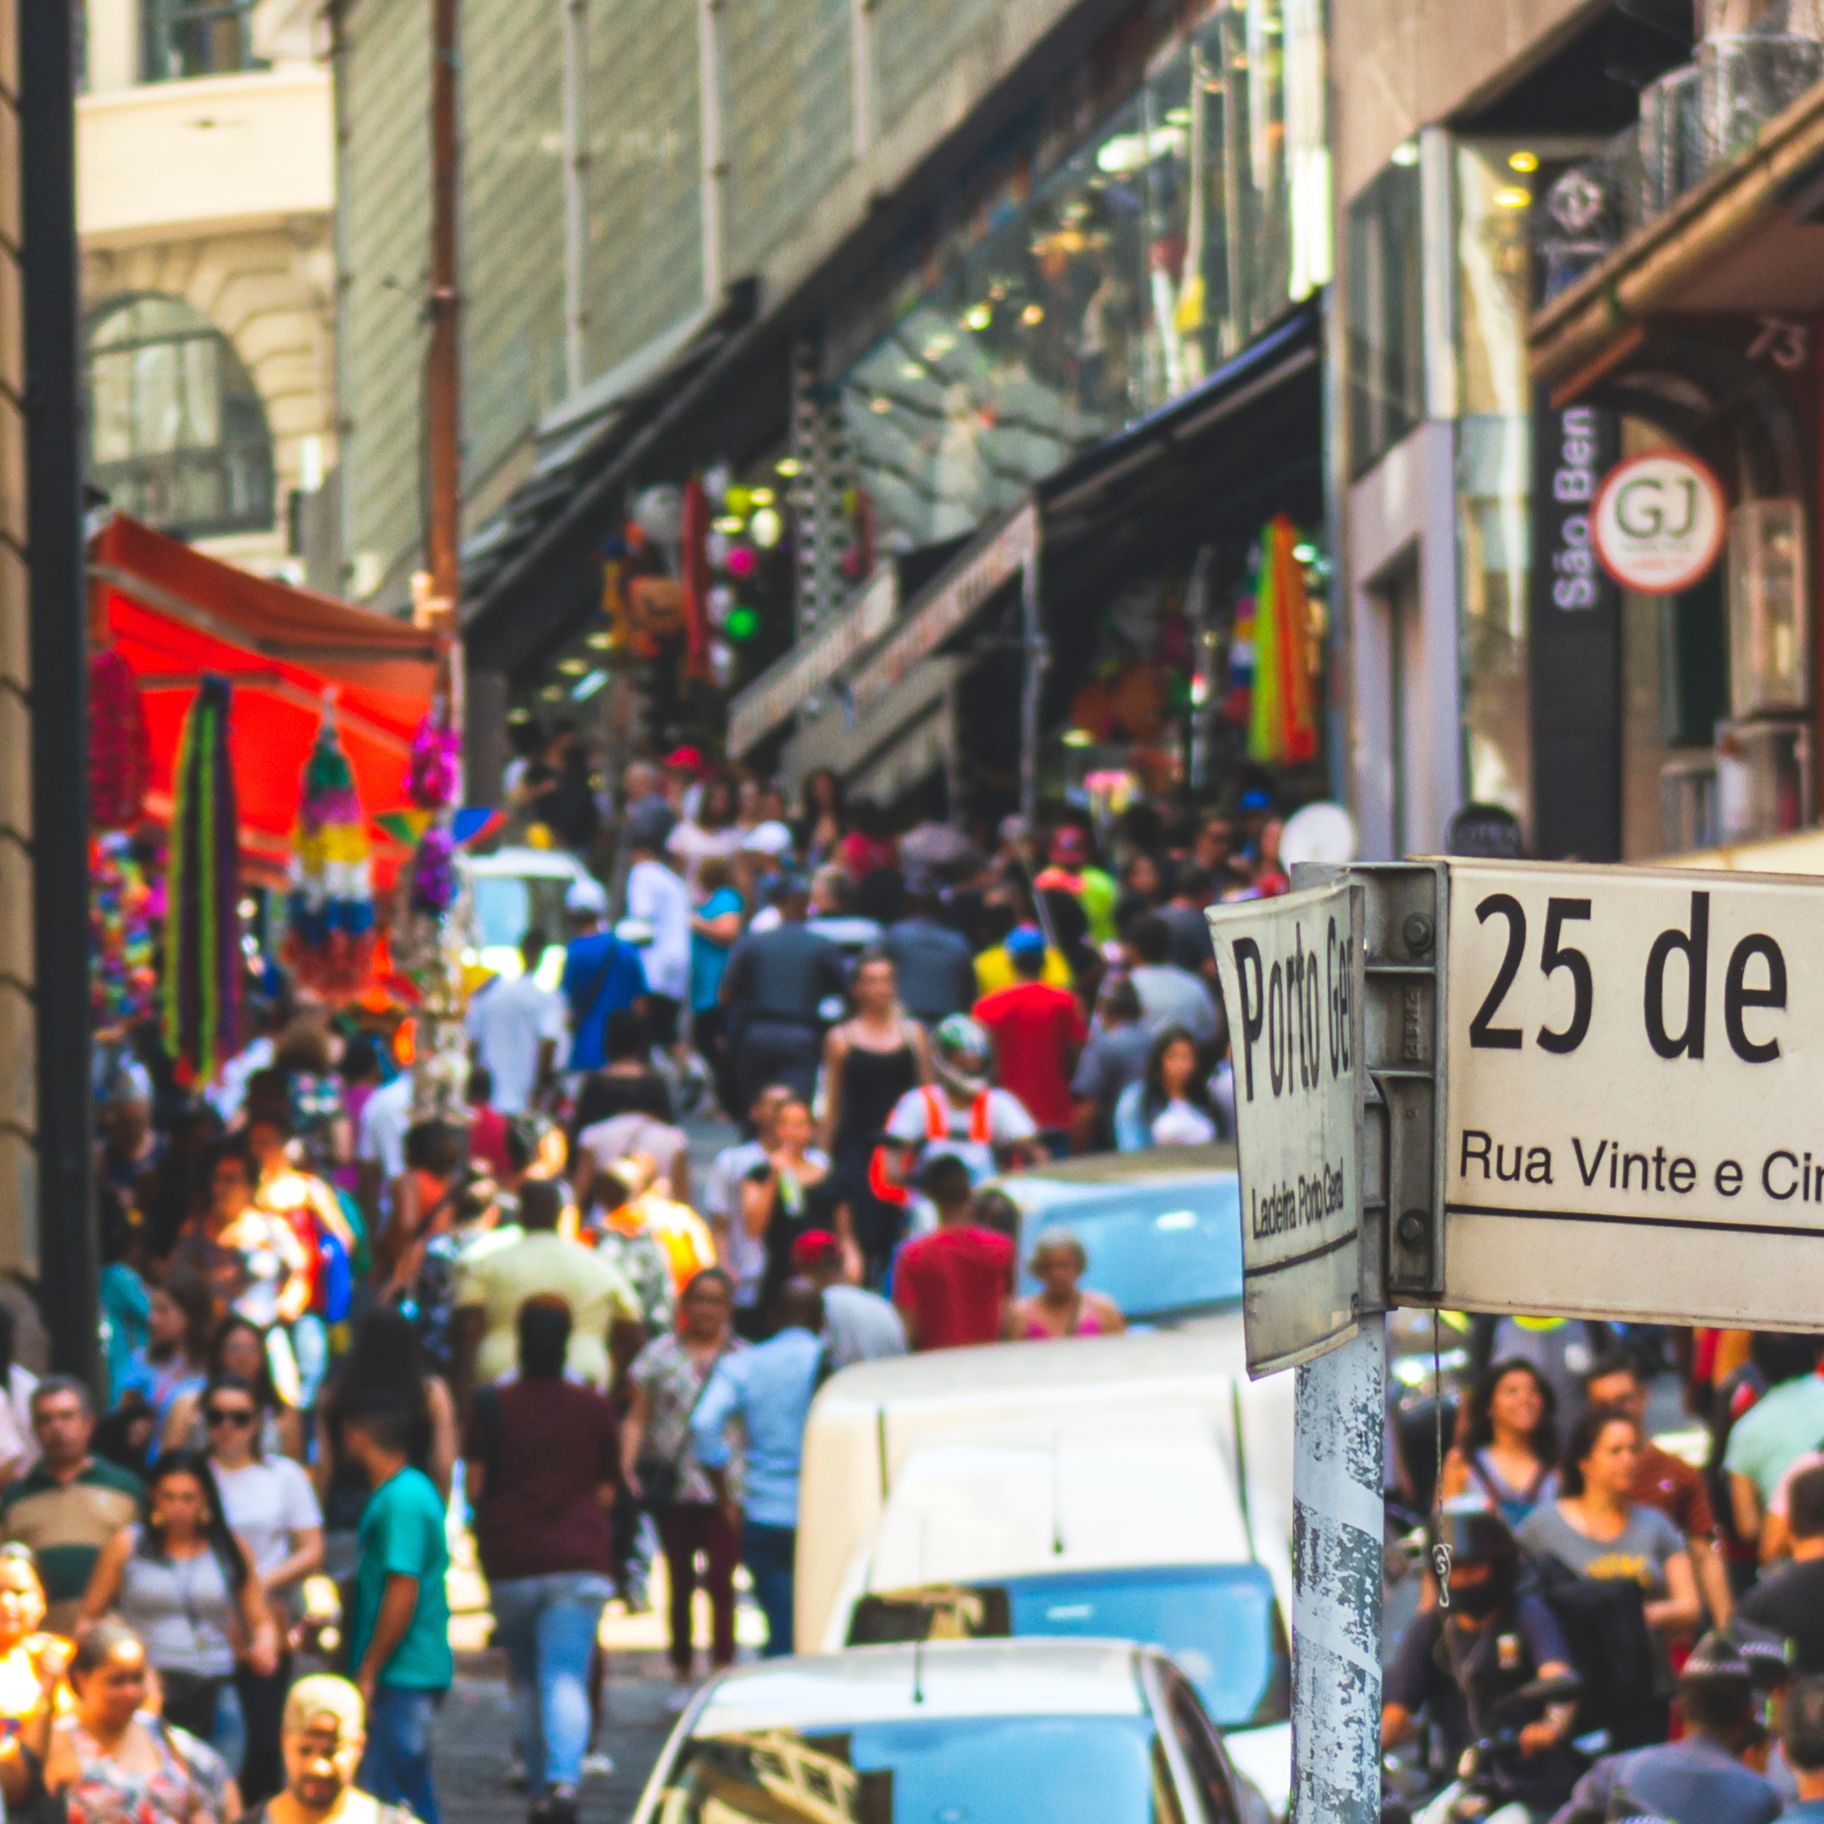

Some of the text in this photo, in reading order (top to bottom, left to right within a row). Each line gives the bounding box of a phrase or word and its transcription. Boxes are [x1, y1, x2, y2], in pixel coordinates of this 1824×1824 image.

[1232, 921, 1320, 1102] Porto
[1469, 892, 1594, 1054] 25
[1642, 890, 1788, 1063] de
[1251, 1180, 1296, 1240] Ladeira
[1297, 1173, 1323, 1226] Porto
[1459, 1129, 1554, 1186] Rua
[1570, 1137, 1698, 1197] Vinte
[1712, 1162, 1745, 1198] e
